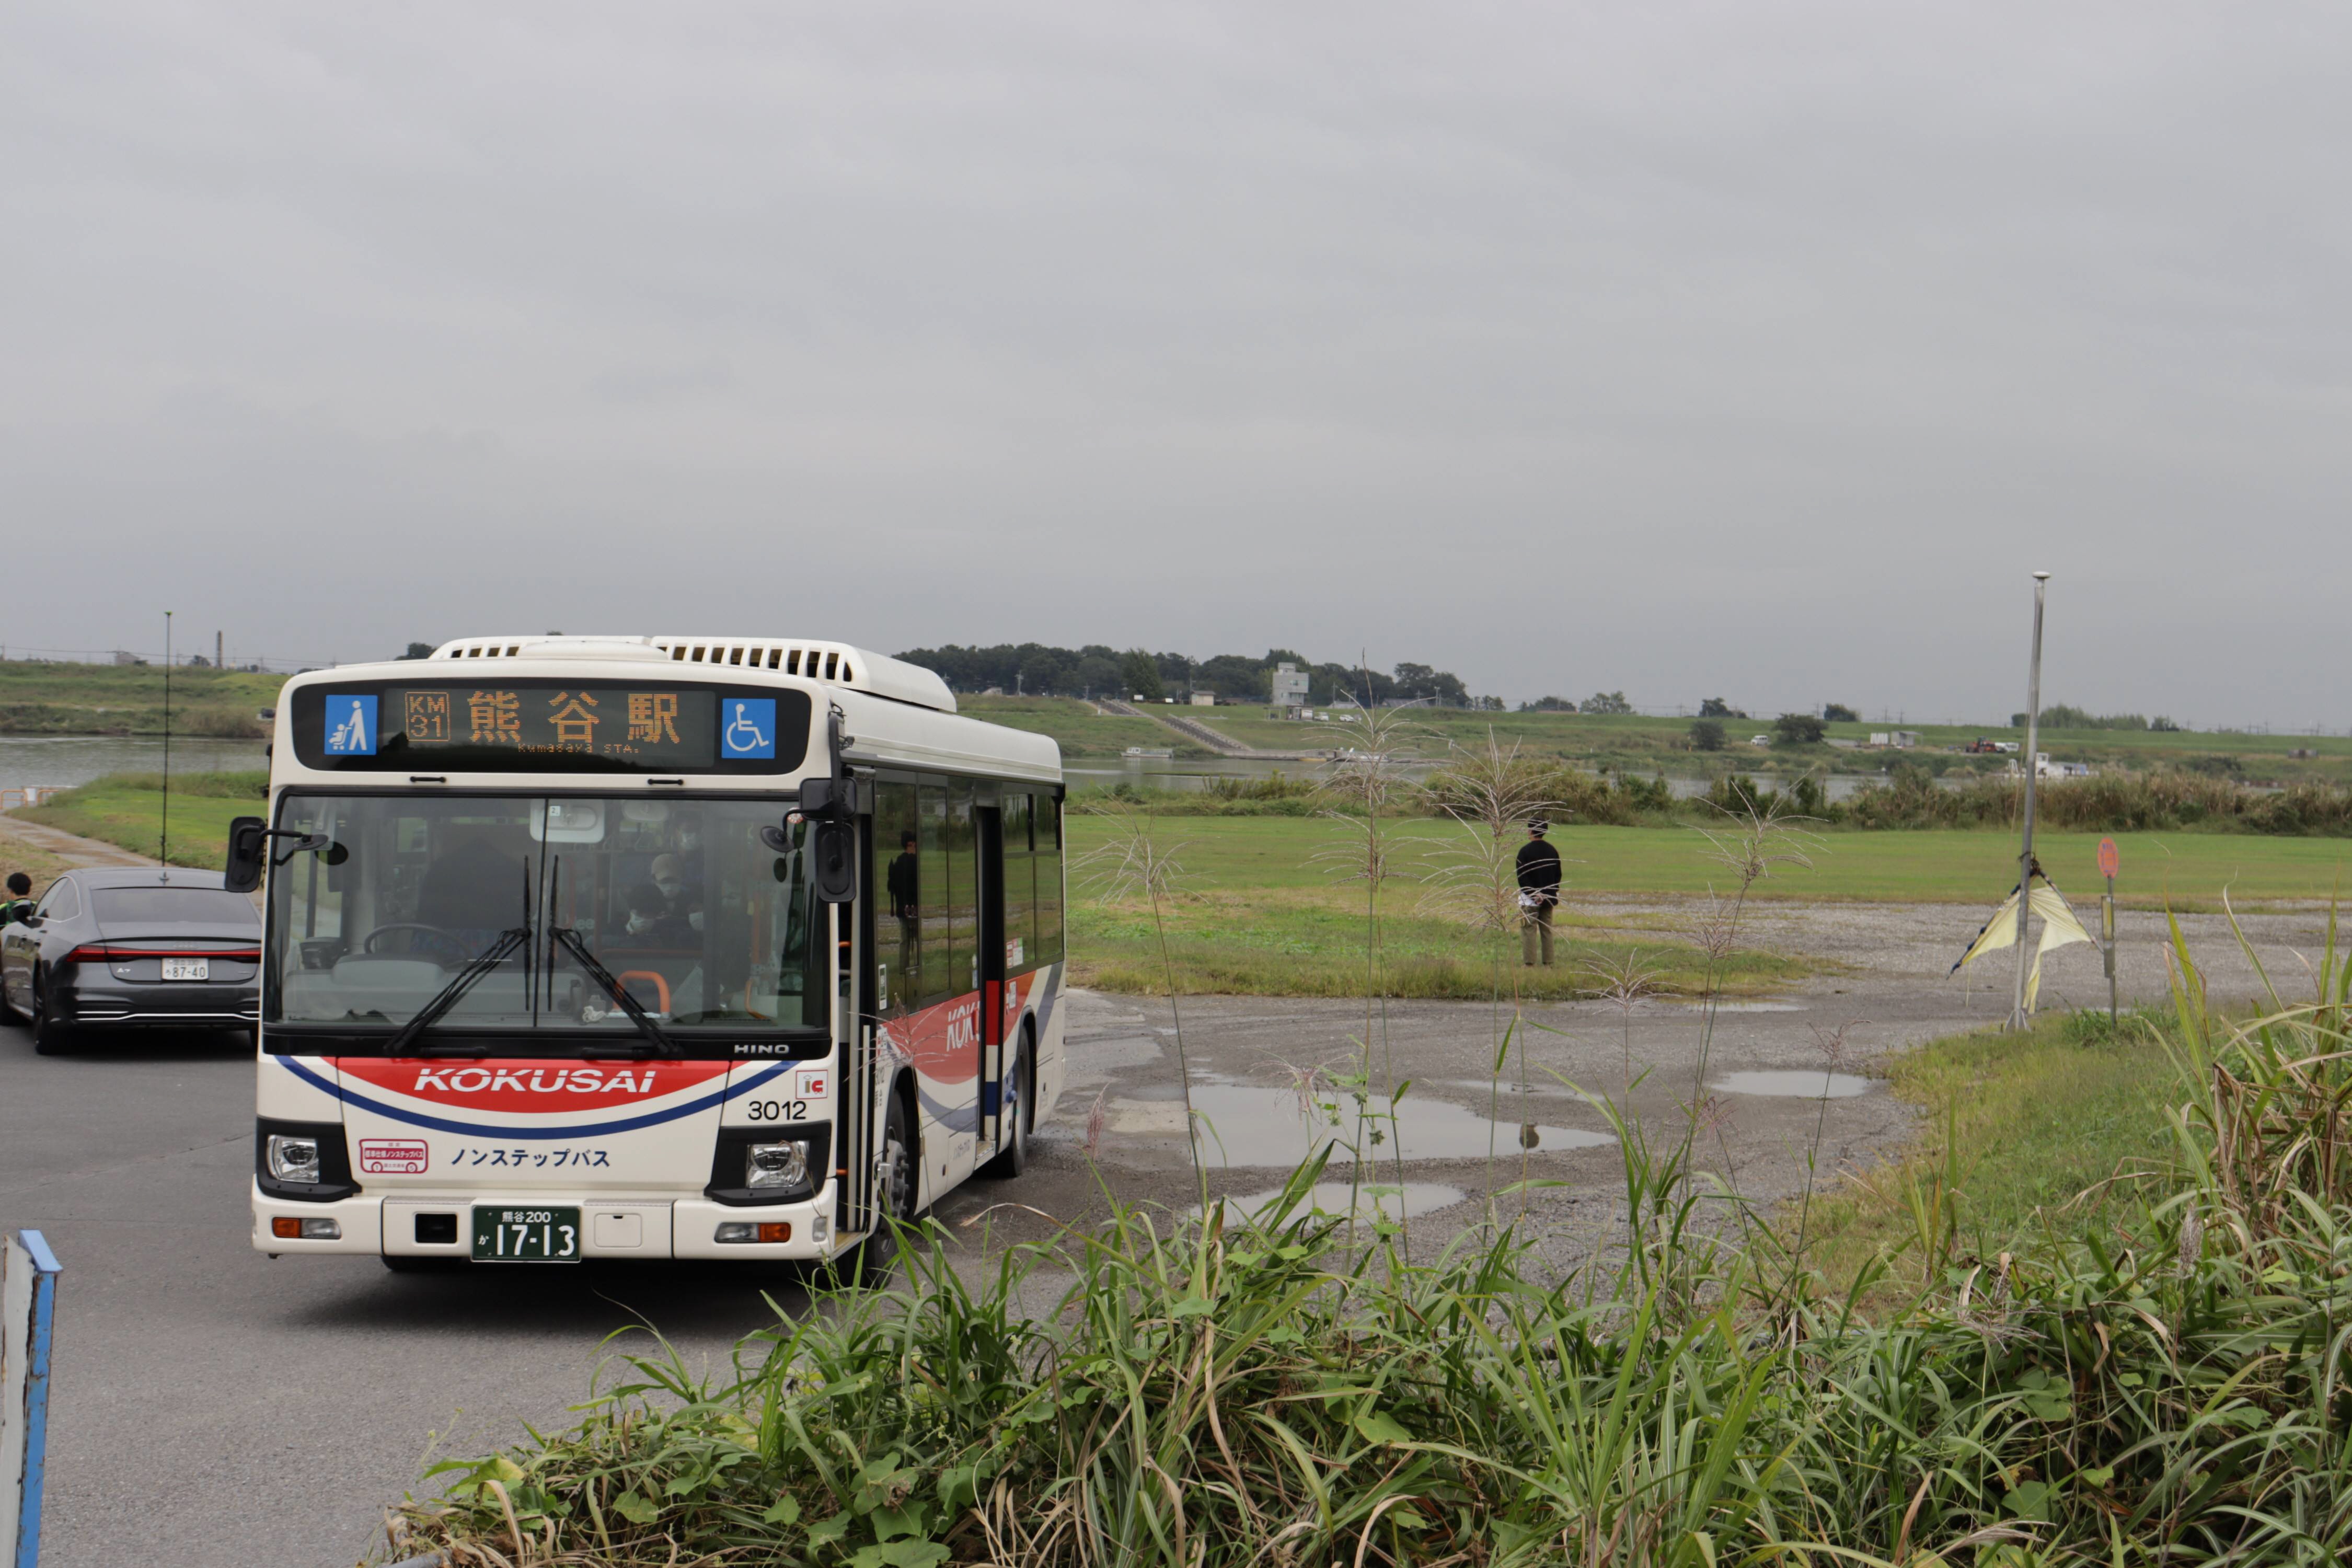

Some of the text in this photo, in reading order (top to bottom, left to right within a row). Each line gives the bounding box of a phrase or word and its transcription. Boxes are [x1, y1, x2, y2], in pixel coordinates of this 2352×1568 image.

[409, 696, 444, 713] KM
[410, 716, 442, 737] 31
[467, 691, 679, 743] 熊谷駅
[172, 967, 205, 977] 87-40
[734, 1044, 789, 1054] HINO
[414, 1068, 656, 1093] KOKUSAI
[748, 1101, 806, 1120] 3012
[451, 1148, 610, 1167] ノンステップバス
[478, 1225, 574, 1256] か 17-13
